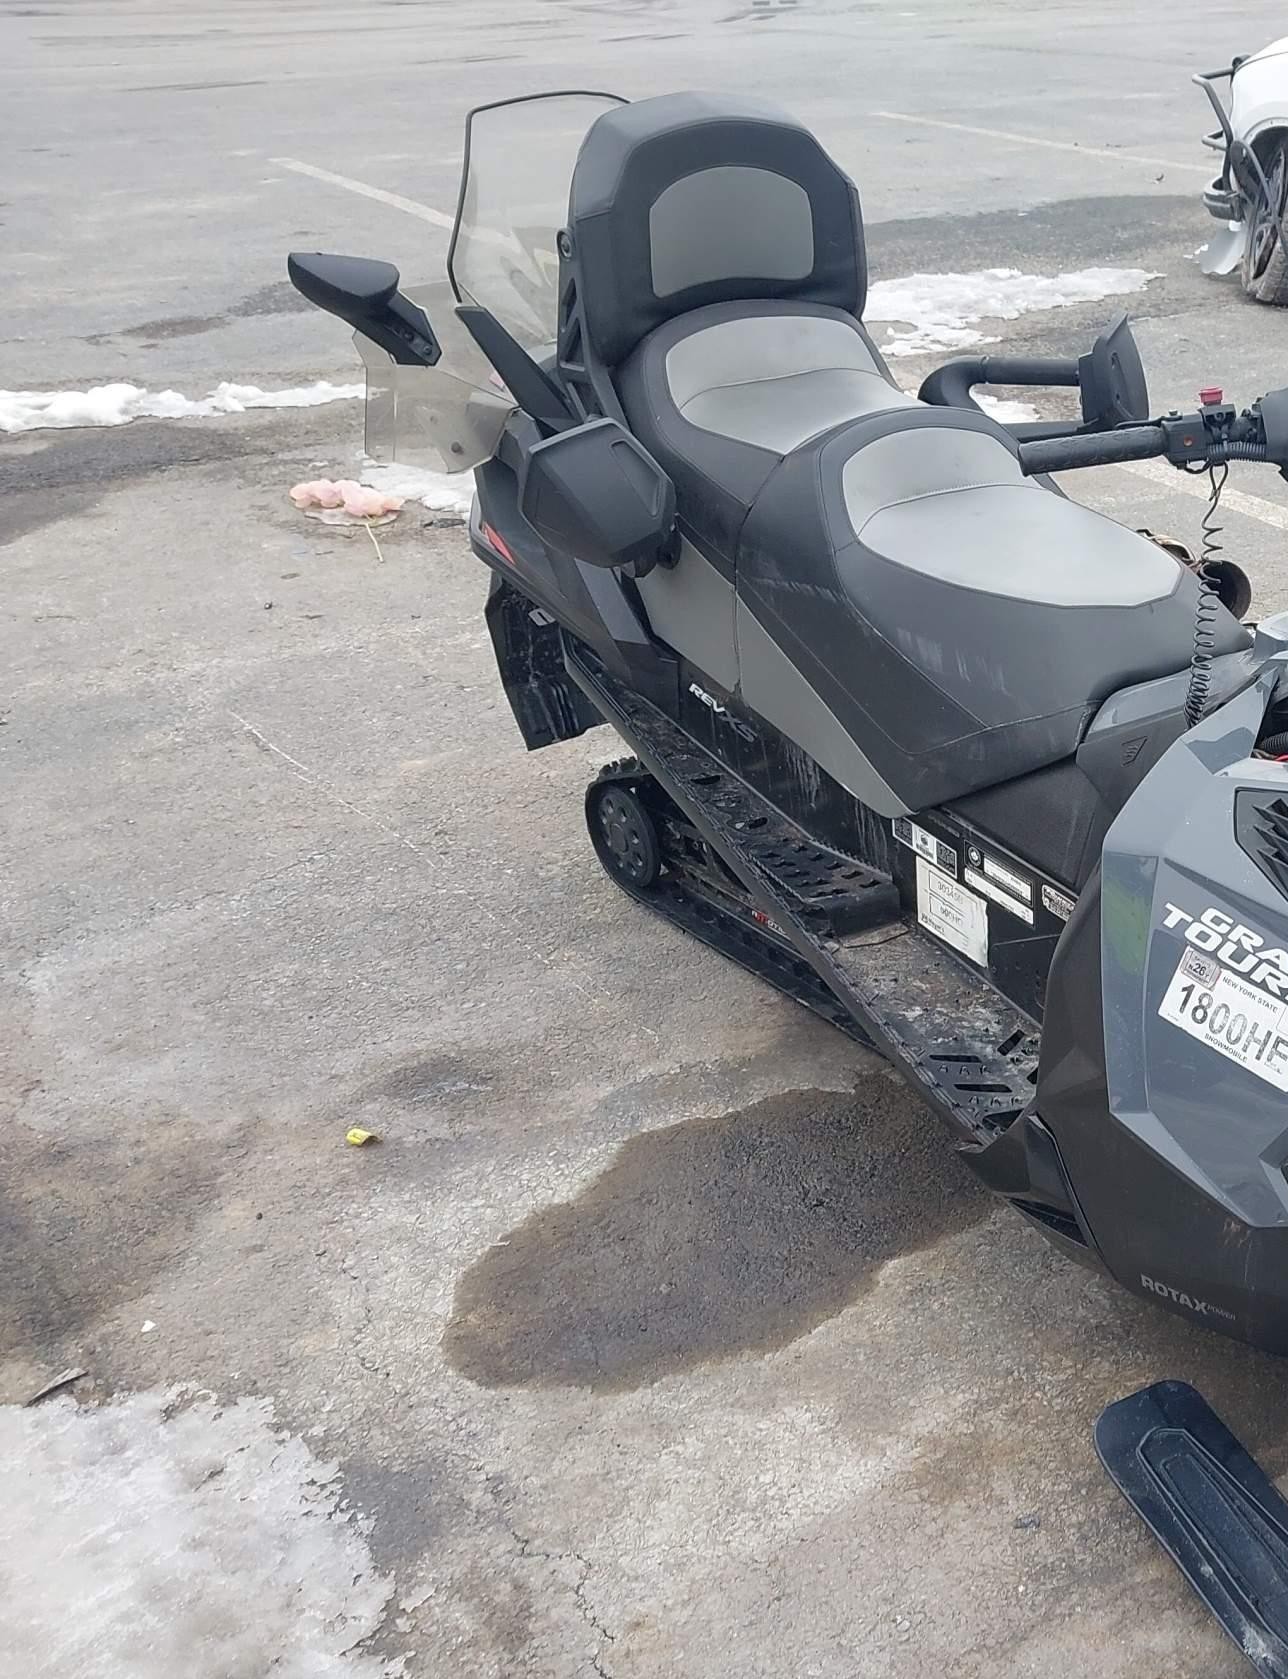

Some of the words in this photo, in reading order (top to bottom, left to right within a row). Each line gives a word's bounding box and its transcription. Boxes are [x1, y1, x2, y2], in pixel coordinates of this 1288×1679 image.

[1222, 976, 1239, 989] NEW
[1238, 985, 1257, 1001] YORK
[1257, 997, 1279, 1014] STATE
[1204, 1032, 1248, 1063] SNOWMOBILE
[1140, 1273, 1208, 1315] ROTAX
